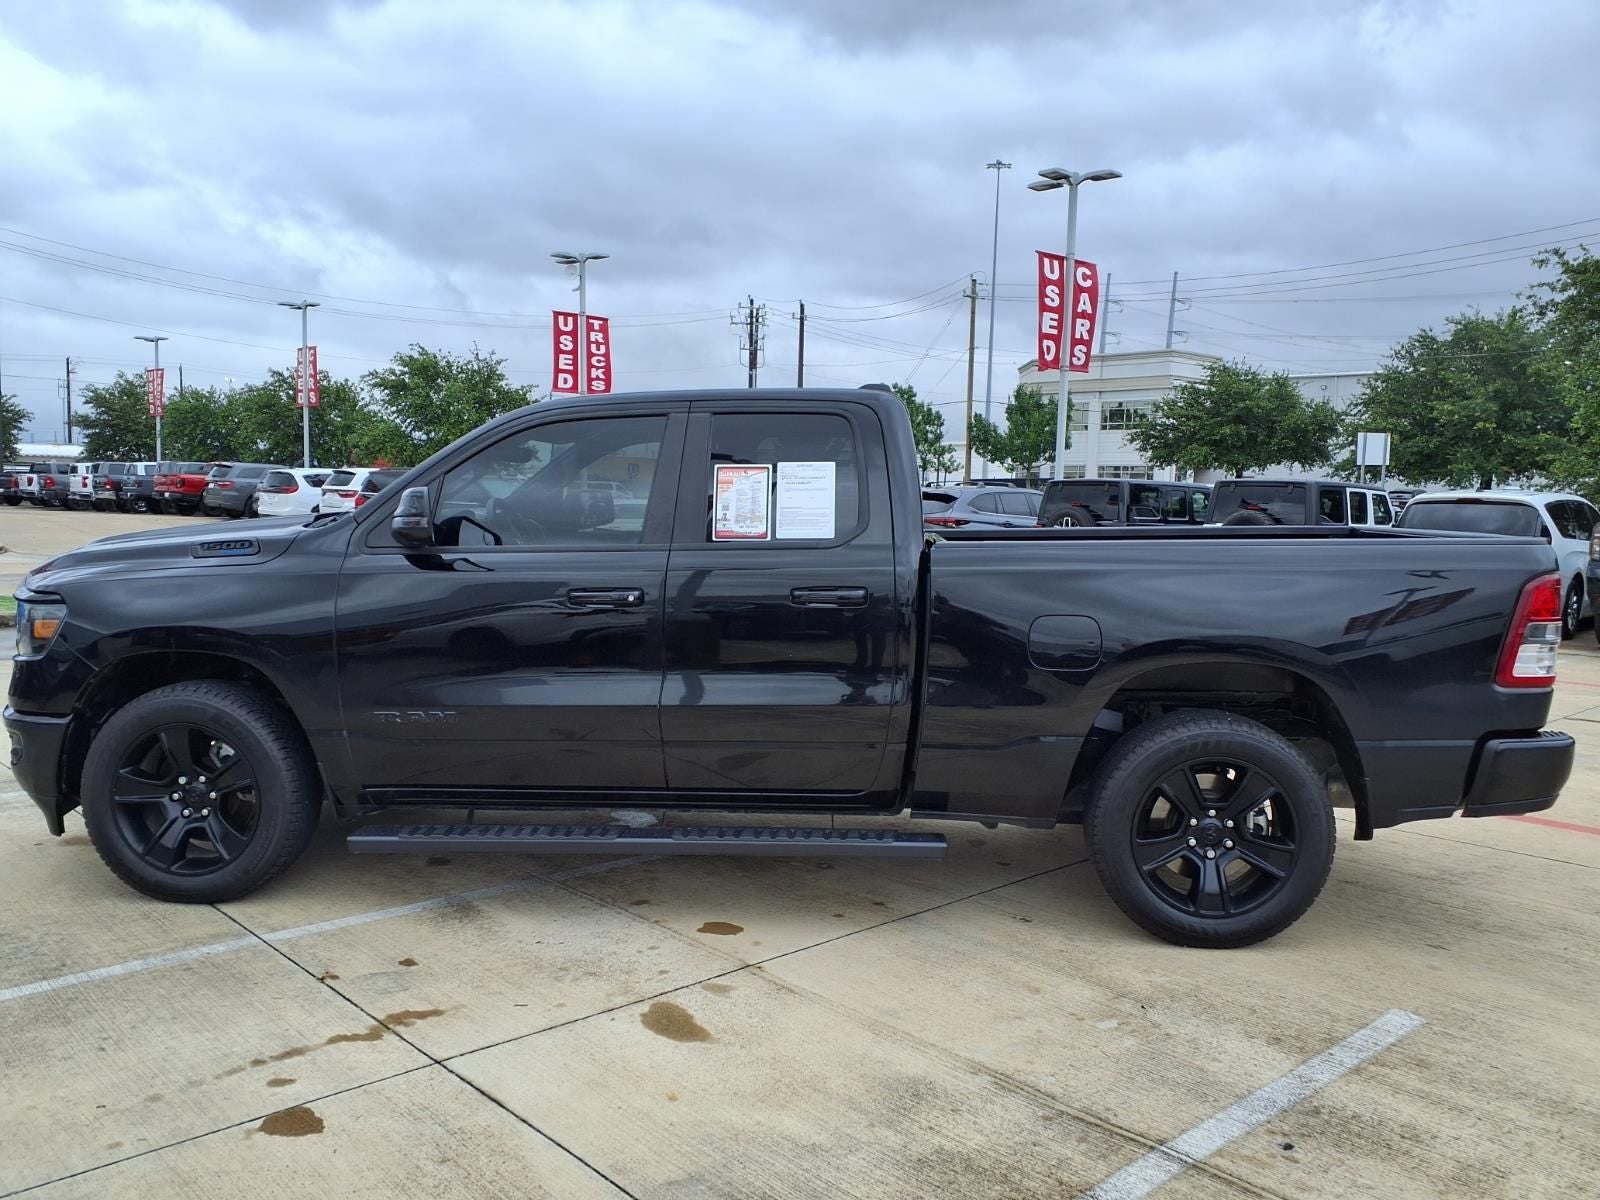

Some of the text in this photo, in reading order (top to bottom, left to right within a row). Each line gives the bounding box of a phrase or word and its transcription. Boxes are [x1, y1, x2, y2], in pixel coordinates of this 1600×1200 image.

[1042, 258, 1060, 361] USED
[1072, 267, 1093, 366] CARS
[308, 349, 316, 403] CARS
[558, 315, 573, 389] USED
[589, 319, 606, 391] TRUCKS
[200, 540, 251, 551] 1500
